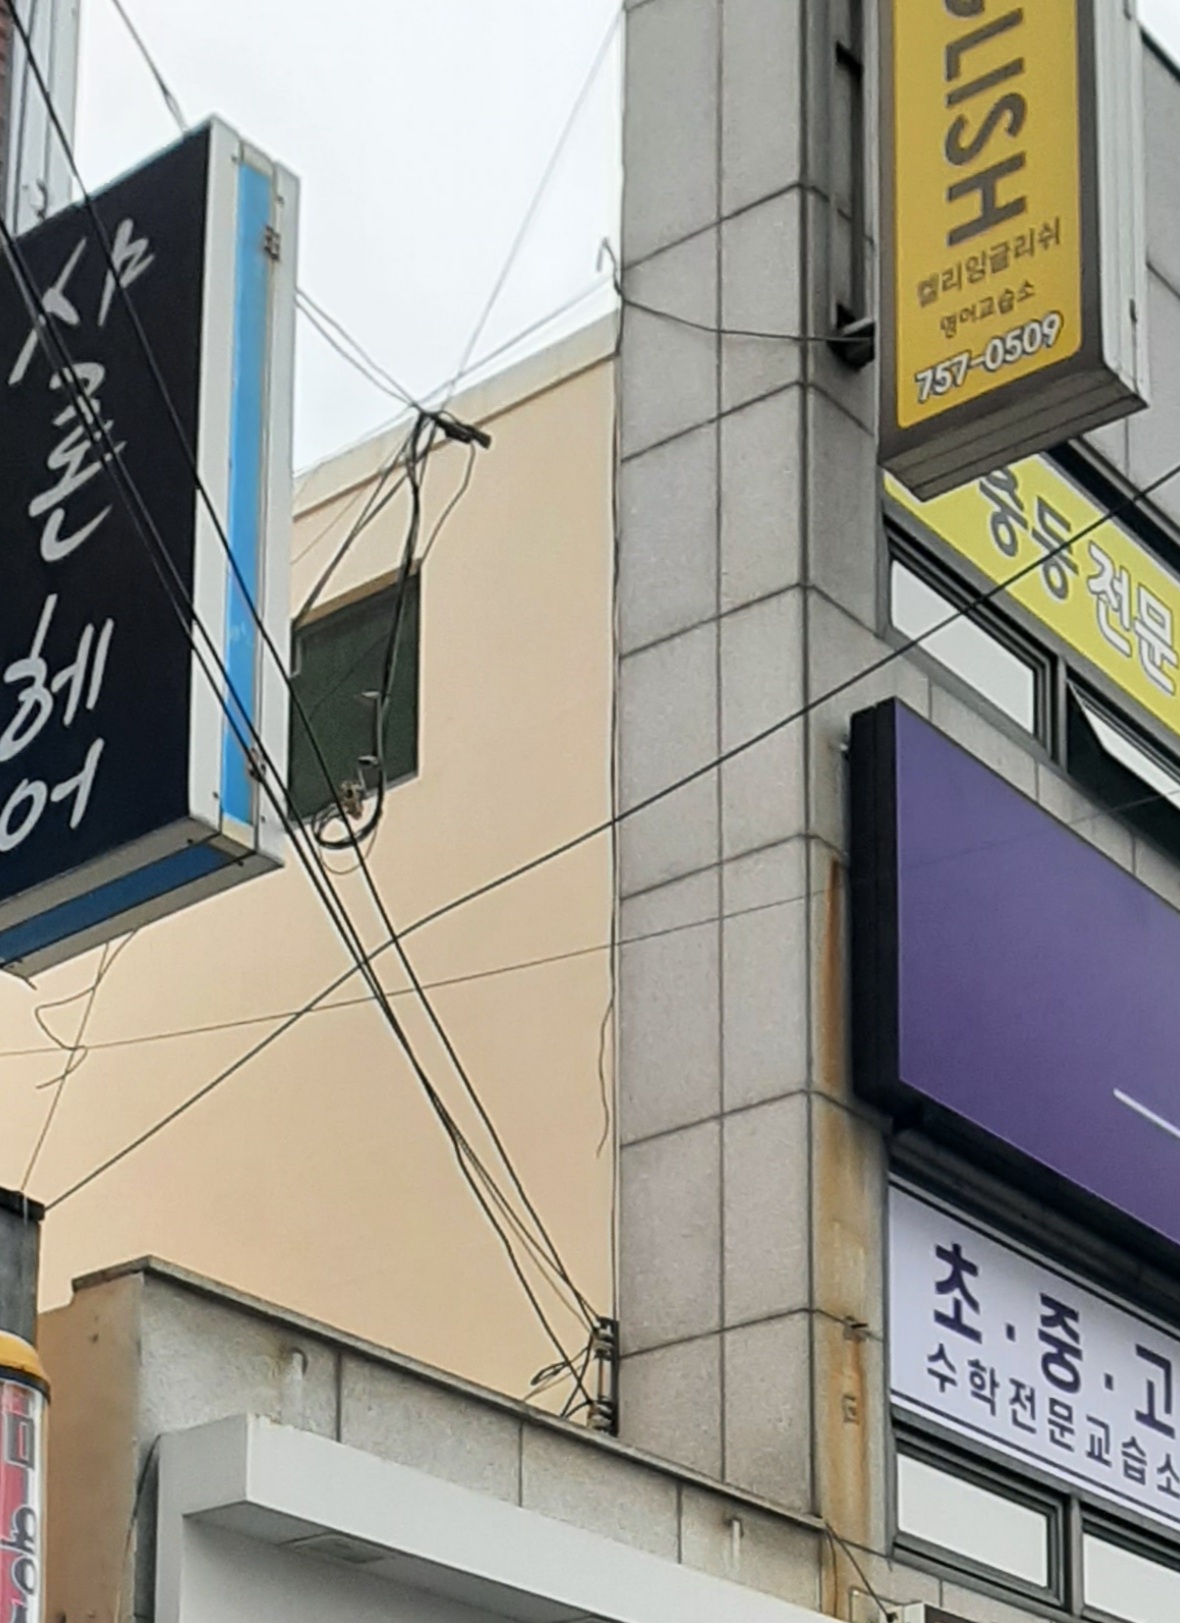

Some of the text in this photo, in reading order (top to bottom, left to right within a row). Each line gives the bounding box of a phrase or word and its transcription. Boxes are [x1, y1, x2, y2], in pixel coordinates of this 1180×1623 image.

[943, 0, 1027, 247] LISH
[914, 310, 1065, 405] 757-0509
[1086, 538, 1180, 697] 전문
